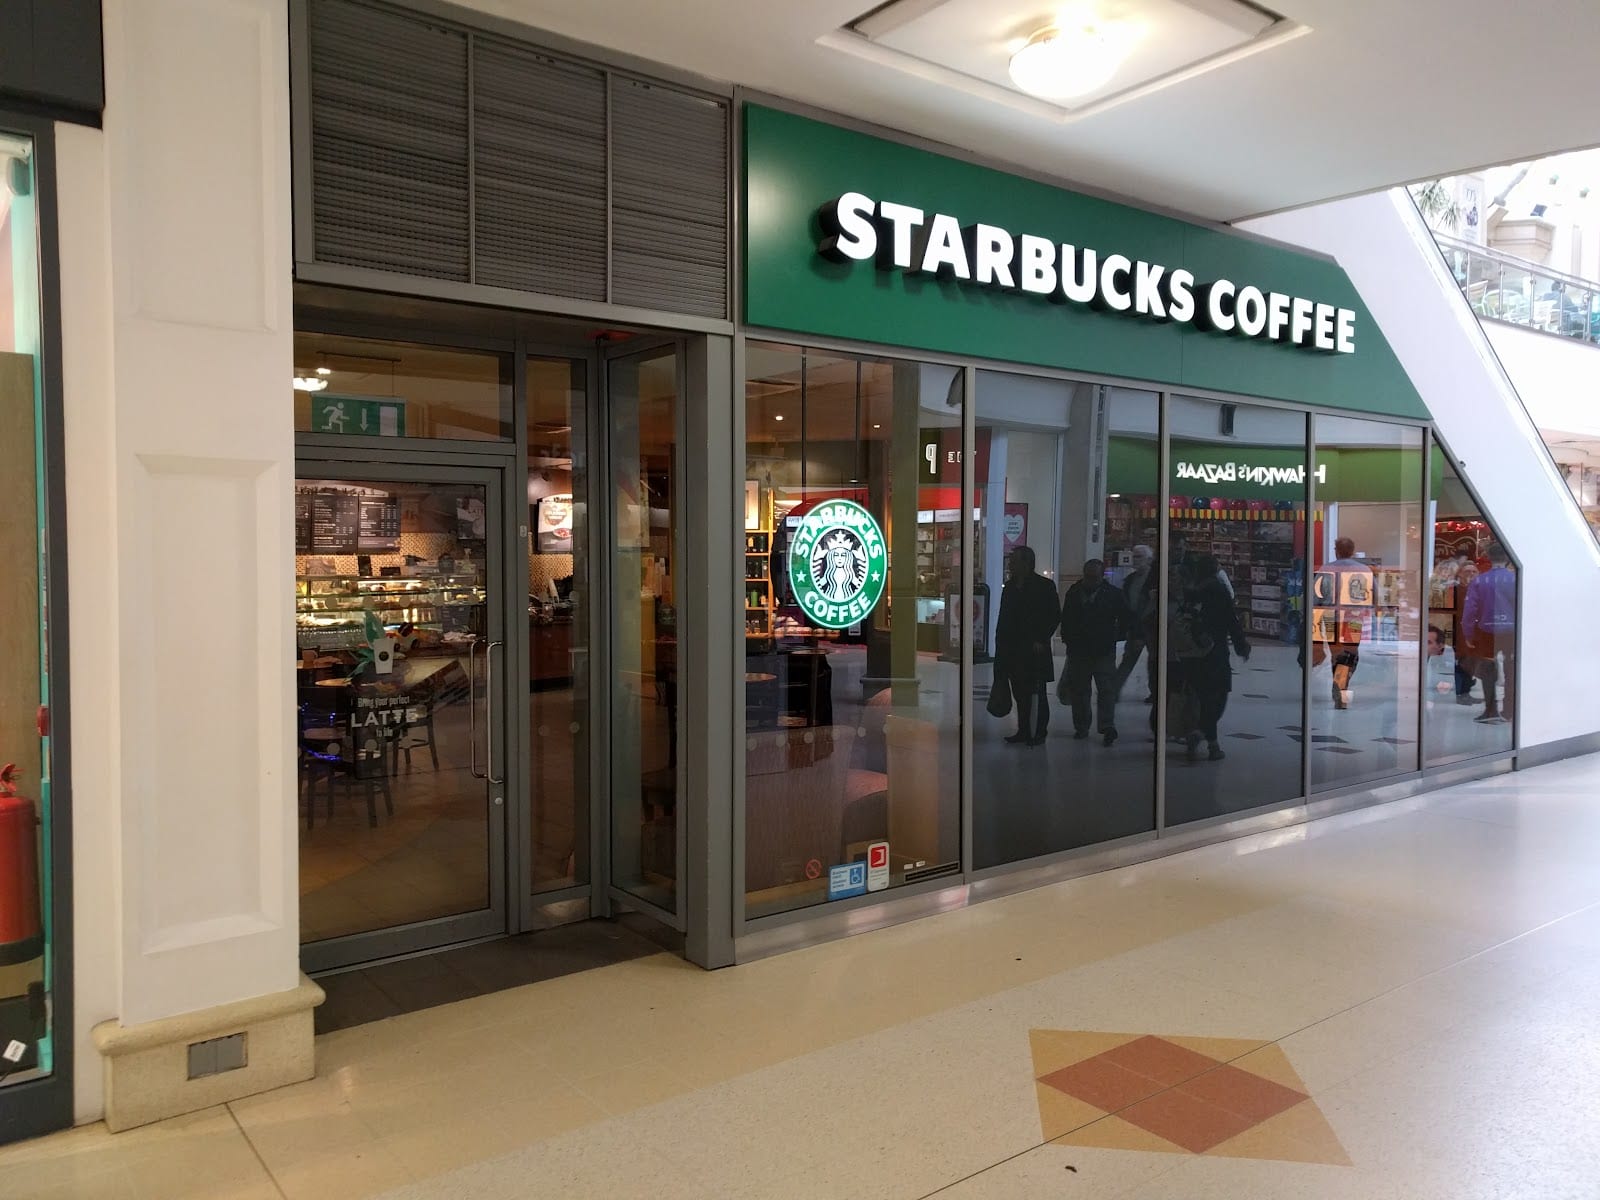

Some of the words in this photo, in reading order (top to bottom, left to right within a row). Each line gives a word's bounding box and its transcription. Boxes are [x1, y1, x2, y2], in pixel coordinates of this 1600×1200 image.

[835, 192, 1195, 323] STARBUCKS
[1208, 279, 1356, 354] COFFEE
[795, 504, 882, 559] STARBUCKS
[804, 591, 871, 622] COFFEE
[351, 708, 417, 727] LATTE
